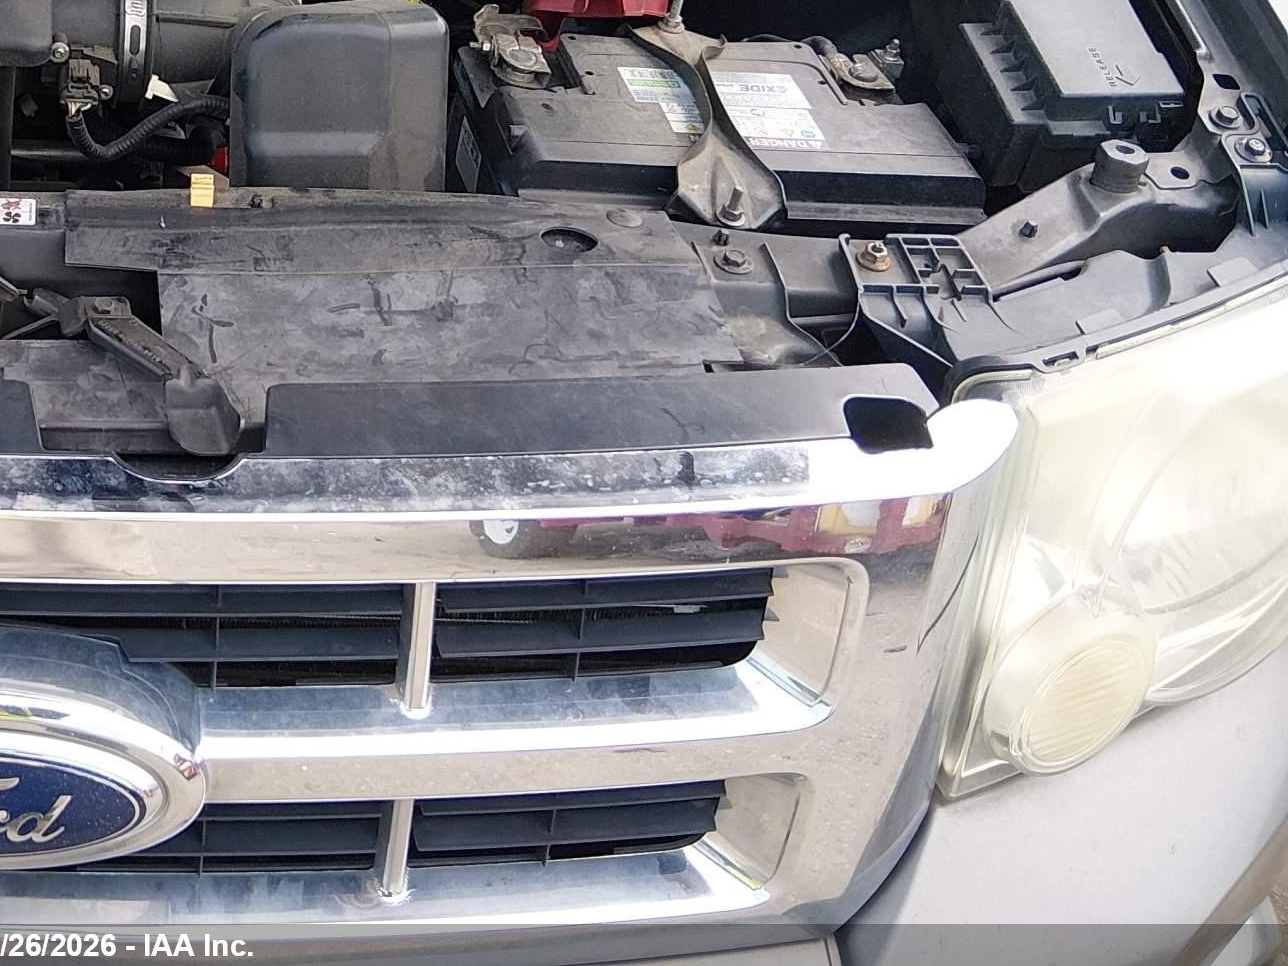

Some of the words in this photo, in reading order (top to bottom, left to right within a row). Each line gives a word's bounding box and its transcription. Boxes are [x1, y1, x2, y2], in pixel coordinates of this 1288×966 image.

[1088, 47, 1118, 87] RELEASE
[738, 84, 787, 93] EXIDE
[750, 137, 809, 148] DANGER
